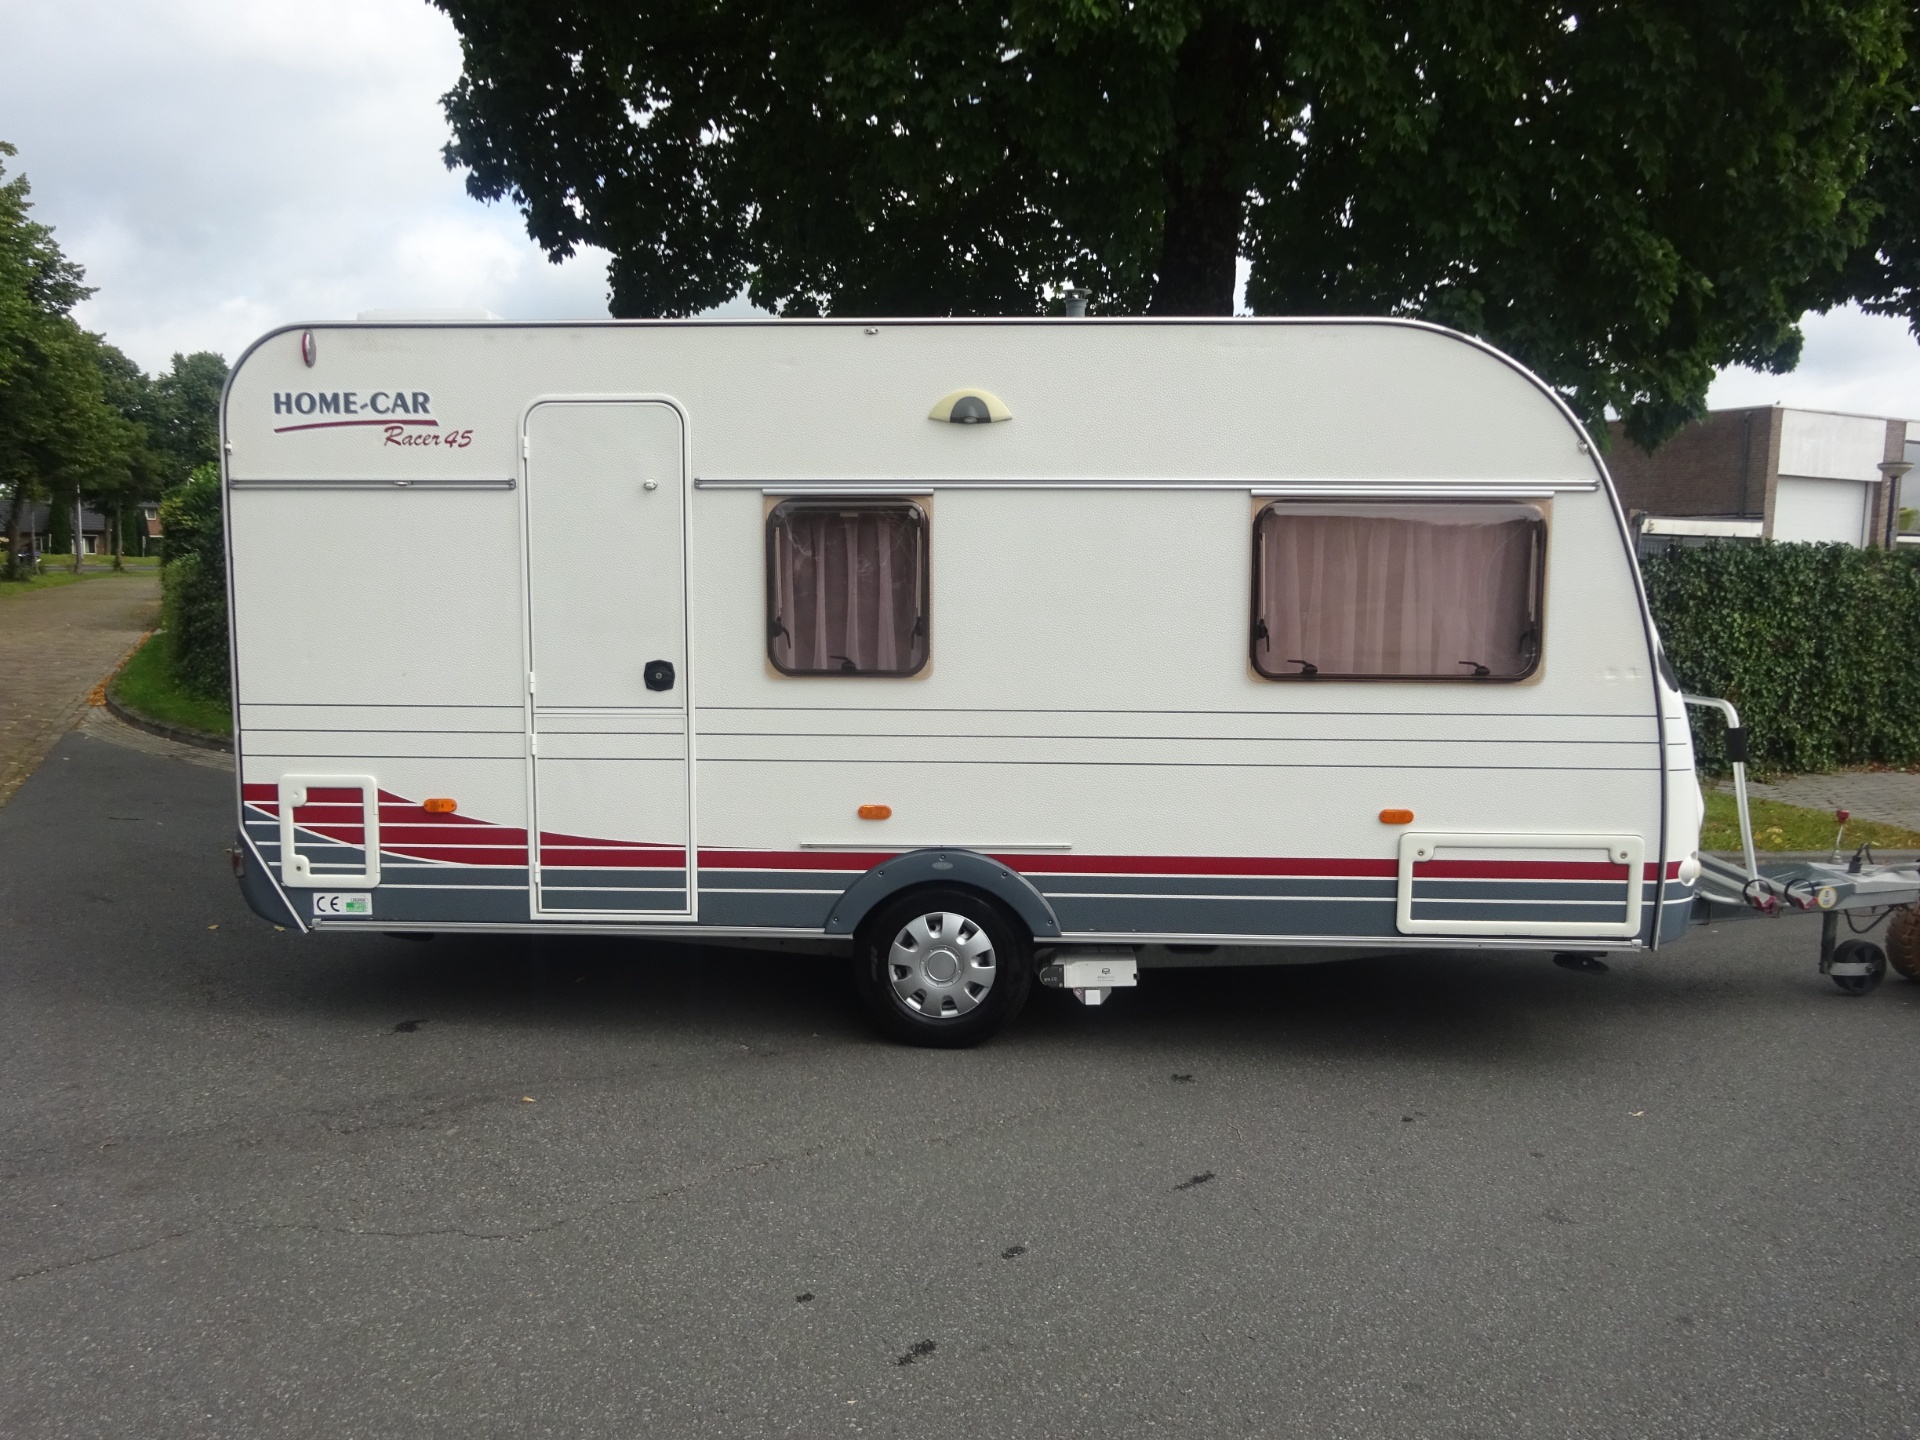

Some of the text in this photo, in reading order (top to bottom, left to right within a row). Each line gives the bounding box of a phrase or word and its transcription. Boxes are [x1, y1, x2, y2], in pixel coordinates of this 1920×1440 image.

[273, 391, 431, 415] HOME-CAR
[383, 425, 474, 448] Racer 45
[316, 895, 340, 913] CE
